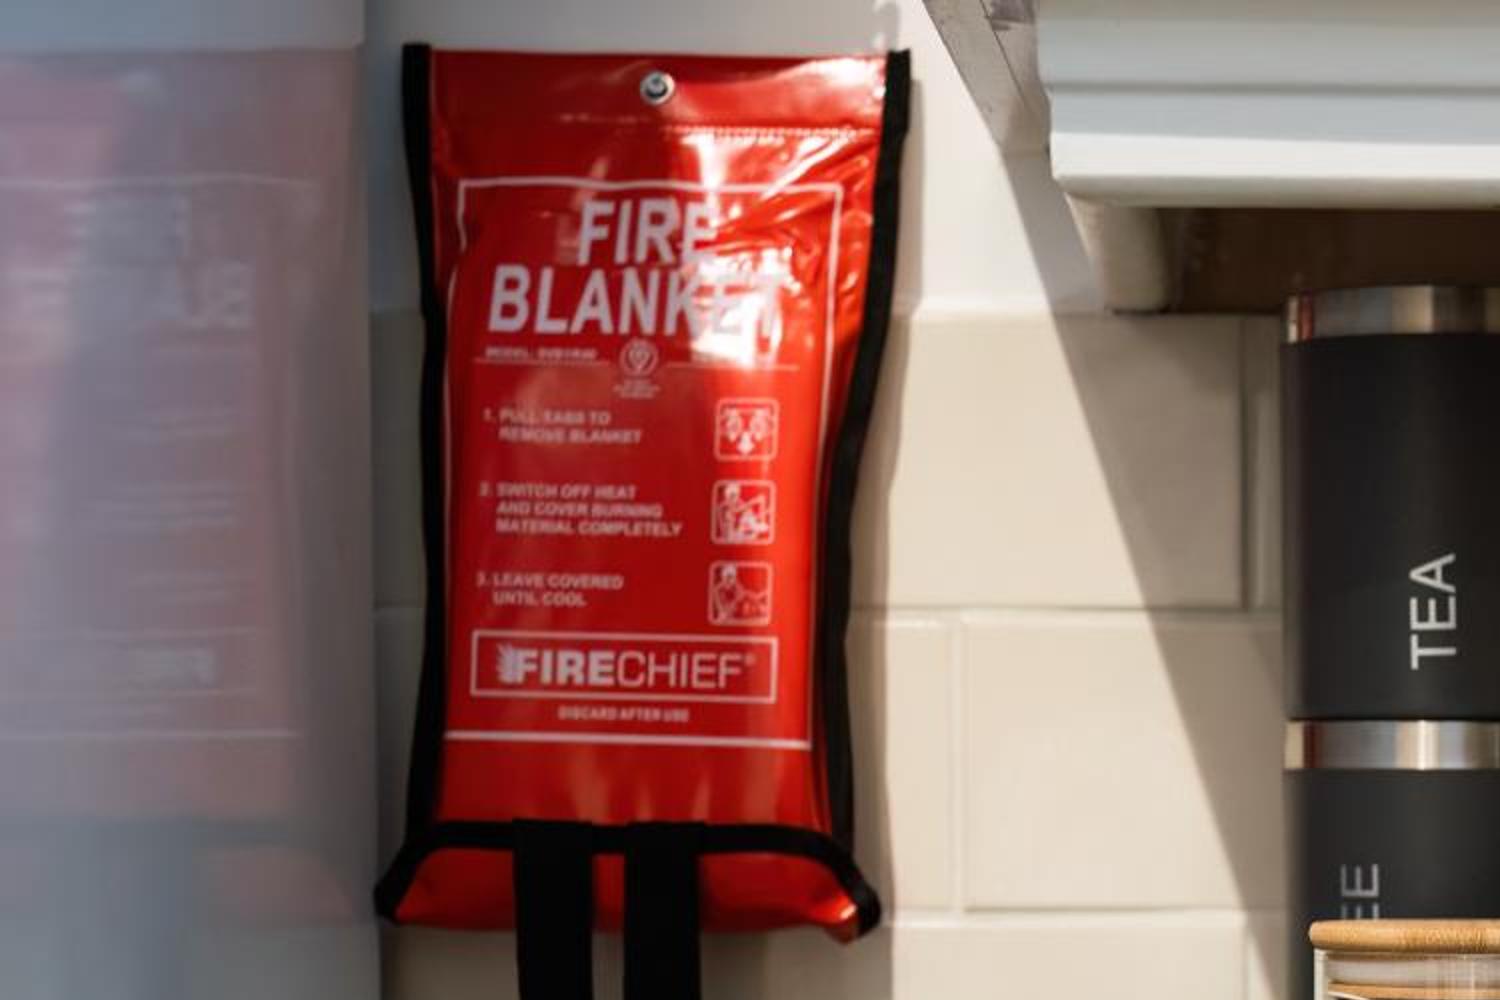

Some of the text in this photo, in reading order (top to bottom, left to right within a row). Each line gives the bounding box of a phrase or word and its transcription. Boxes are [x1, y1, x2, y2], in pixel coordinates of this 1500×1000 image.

[577, 196, 721, 266] FIRE
[578, 520, 683, 537] COMPLETELY
[493, 572, 545, 588] LEAVE
[547, 573, 625, 590] COVERED
[542, 592, 587, 607] COOL
[1409, 552, 1457, 671] TEA
